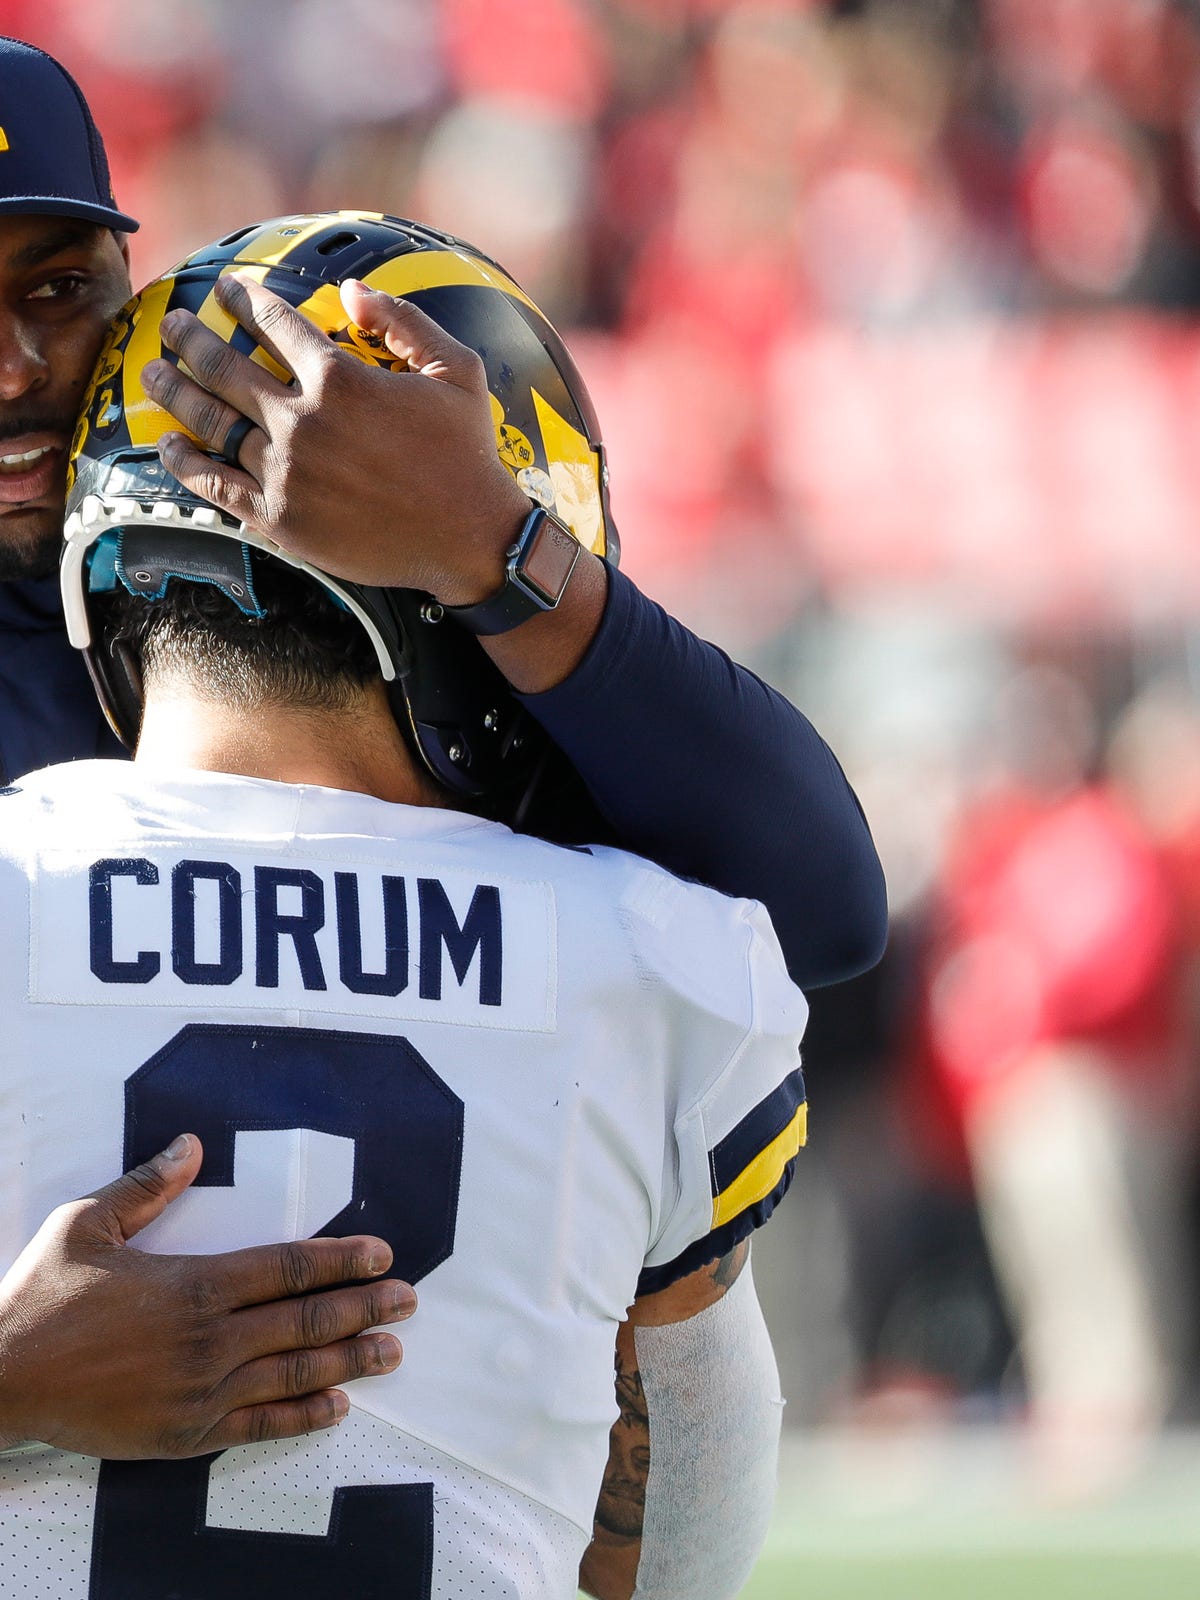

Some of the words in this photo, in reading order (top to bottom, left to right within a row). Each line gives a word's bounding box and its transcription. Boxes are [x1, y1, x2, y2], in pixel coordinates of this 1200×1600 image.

[95, 388, 113, 429] 2
[88, 857, 502, 1006] CORUM
[88, 1022, 465, 1600] 2
